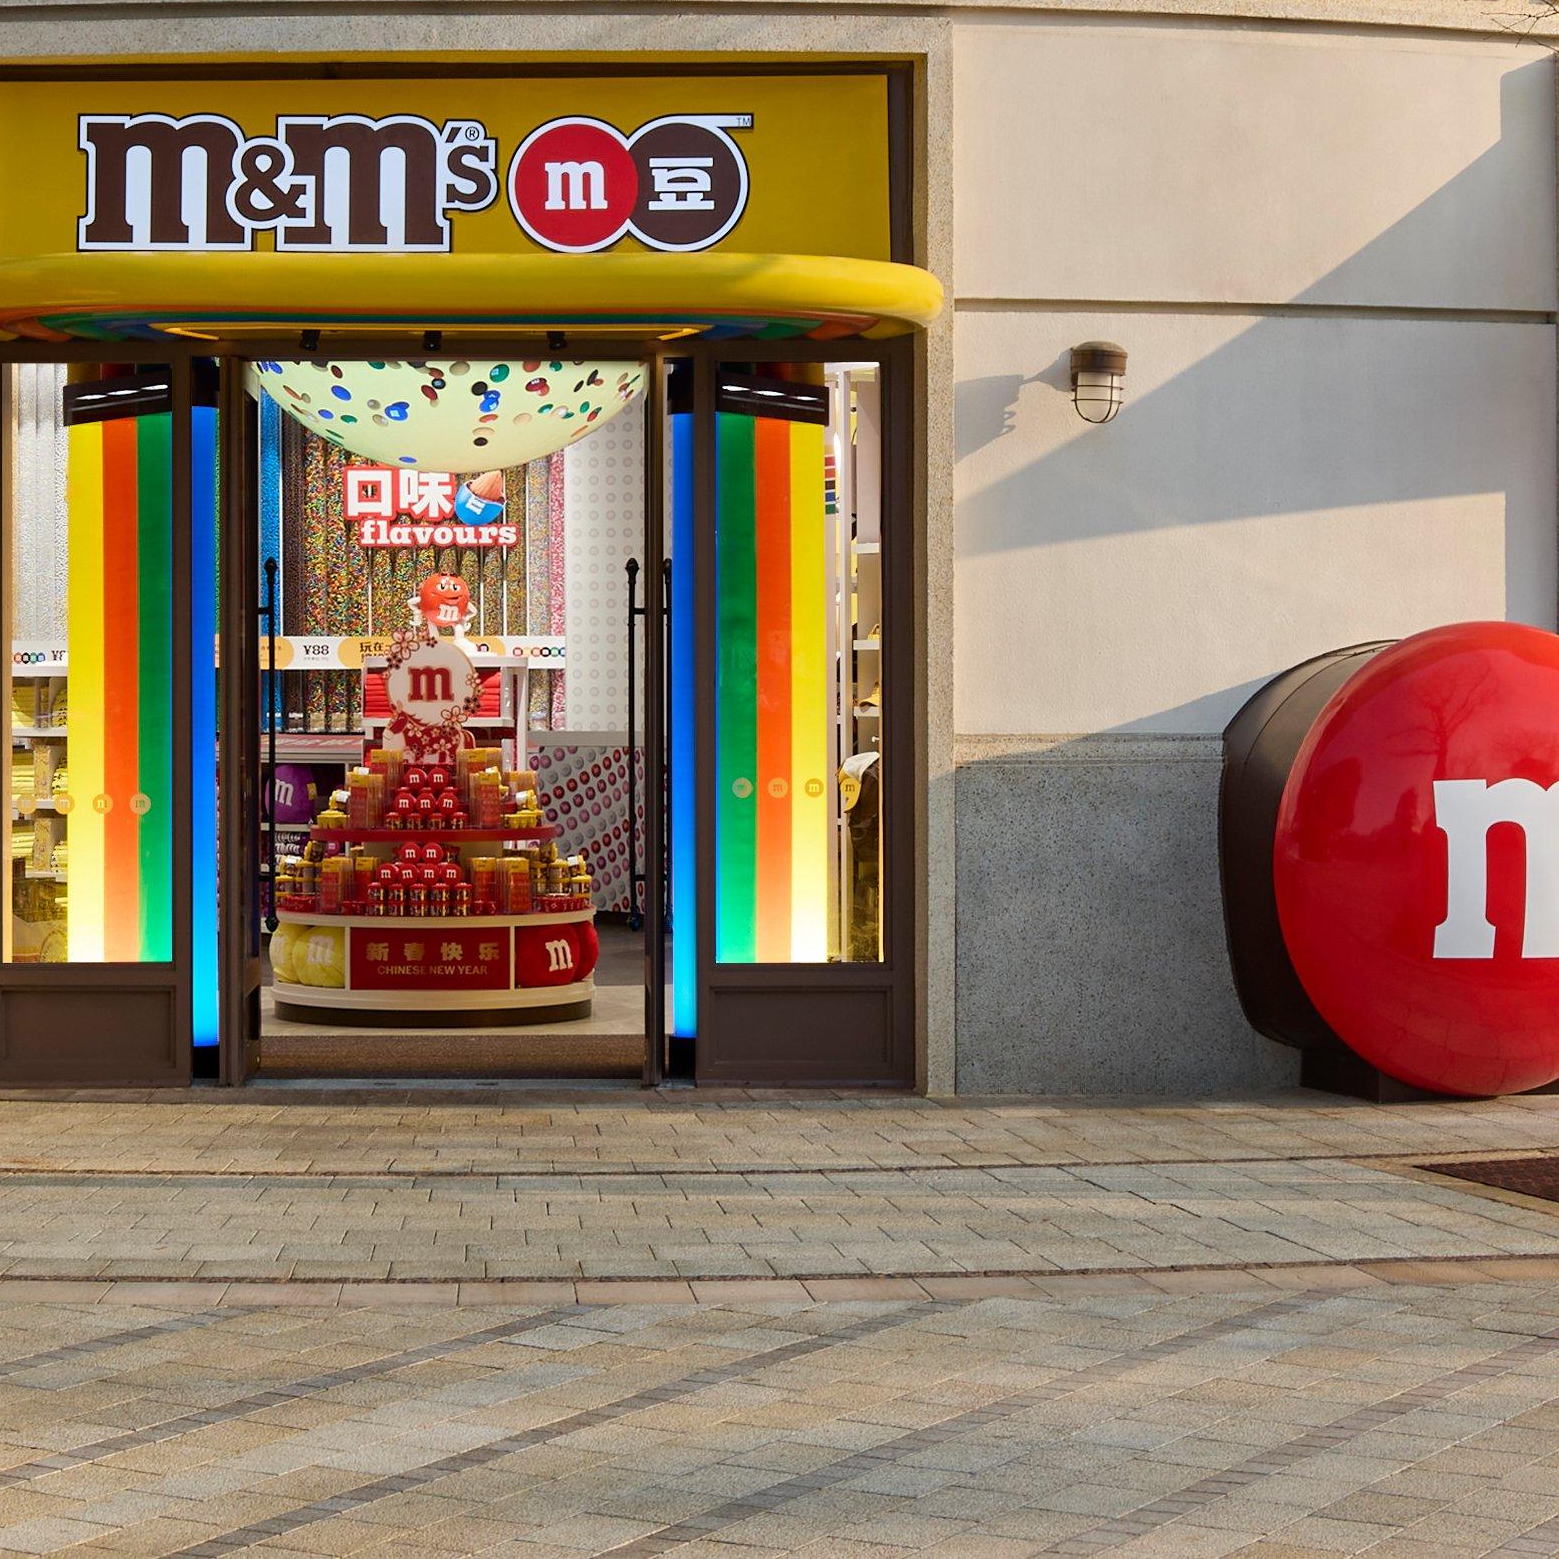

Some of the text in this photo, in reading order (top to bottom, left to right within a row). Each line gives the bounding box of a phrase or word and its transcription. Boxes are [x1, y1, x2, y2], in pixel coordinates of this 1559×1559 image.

[544, 160, 608, 211] m
[648, 156, 715, 211] 豆
[347, 469, 453, 519] 口味
[360, 519, 518, 545] flavours
[437, 603, 460, 621] m
[408, 665, 455, 702] m
[409, 774, 420, 783] m
[433, 773, 444, 783] m
[398, 799, 410, 809] m
[420, 799, 431, 809] m
[442, 798, 454, 809] m
[405, 849, 416, 858] m
[426, 849, 437, 858] m
[380, 869, 391, 879] m
[402, 869, 413, 879] m
[424, 869, 435, 879] m
[446, 869, 457, 879] m
[366, 942, 500, 962] 新春快乐
[545, 938, 574, 972] m
[377, 965, 488, 975] CHINESE NEW YEAR
